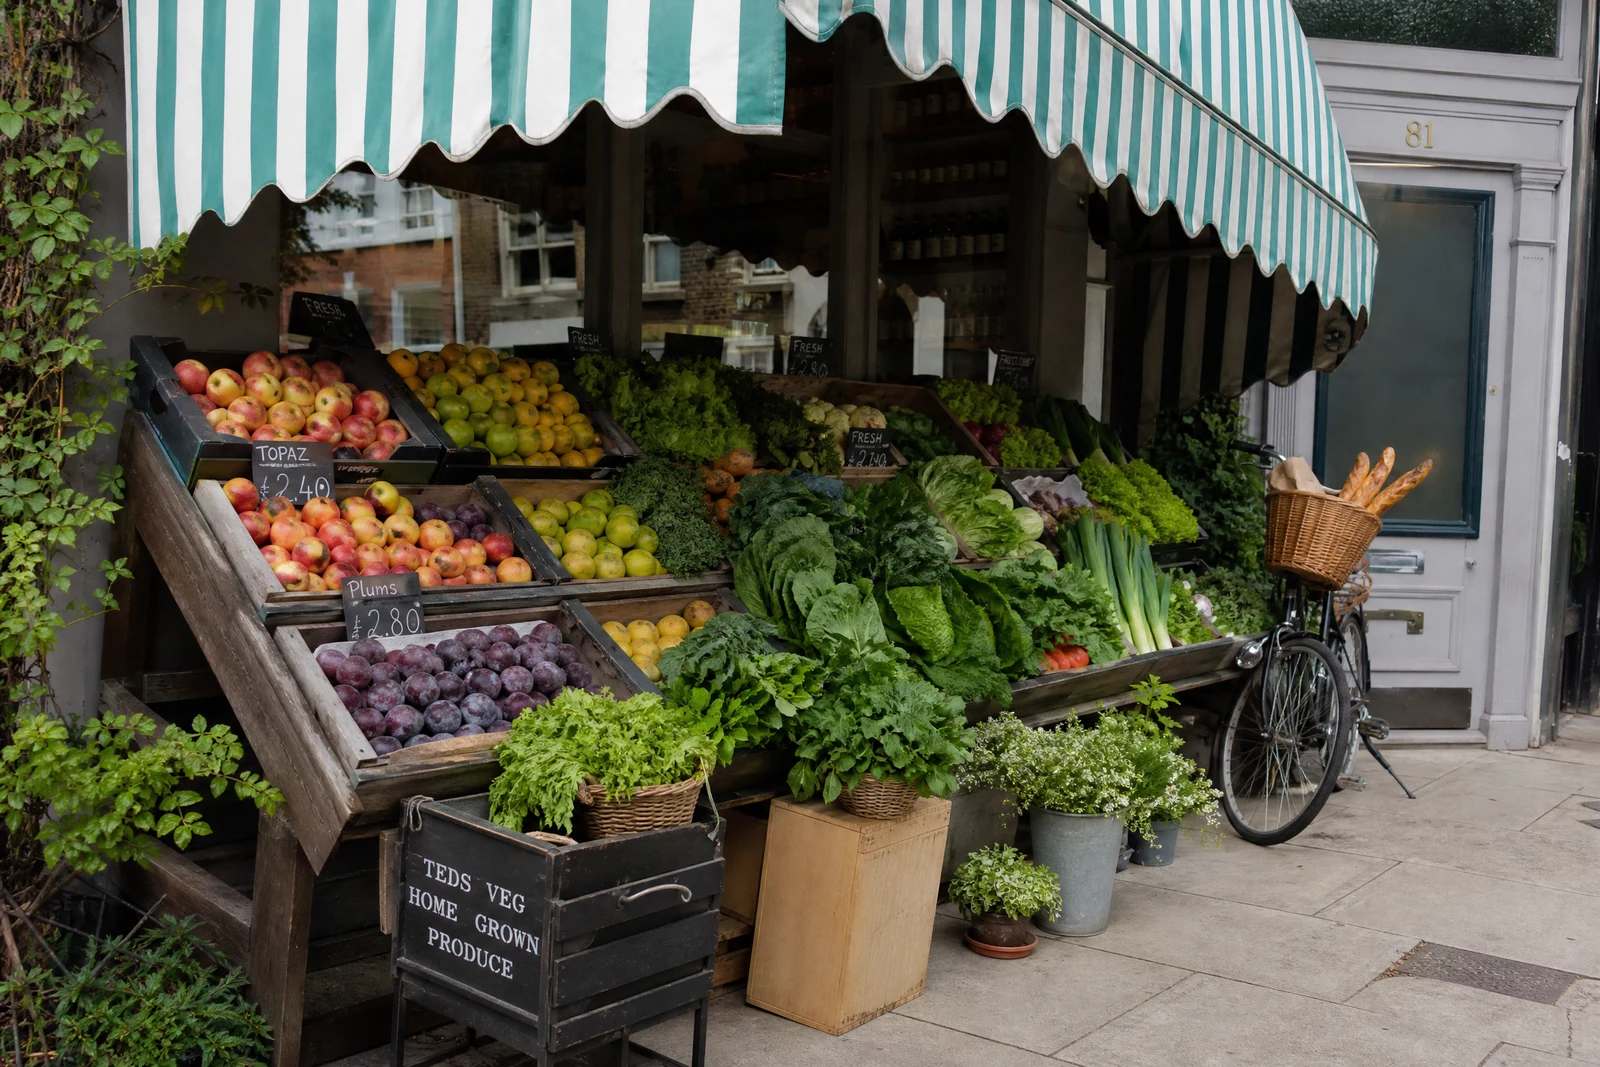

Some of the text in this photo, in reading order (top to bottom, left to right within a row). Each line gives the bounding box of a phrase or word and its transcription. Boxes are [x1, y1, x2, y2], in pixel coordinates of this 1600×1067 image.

[1405, 119, 1433, 149] 81
[793, 340, 824, 354] FRESH
[851, 430, 883, 444] FRESH
[255, 445, 310, 462] TOPAZ
[346, 579, 398, 599] Plums
[351, 607, 420, 640] £2.80
[423, 858, 526, 914] TEDS VEG
[408, 885, 540, 956] HOME GROWN
[427, 926, 513, 979] PRODUCE
